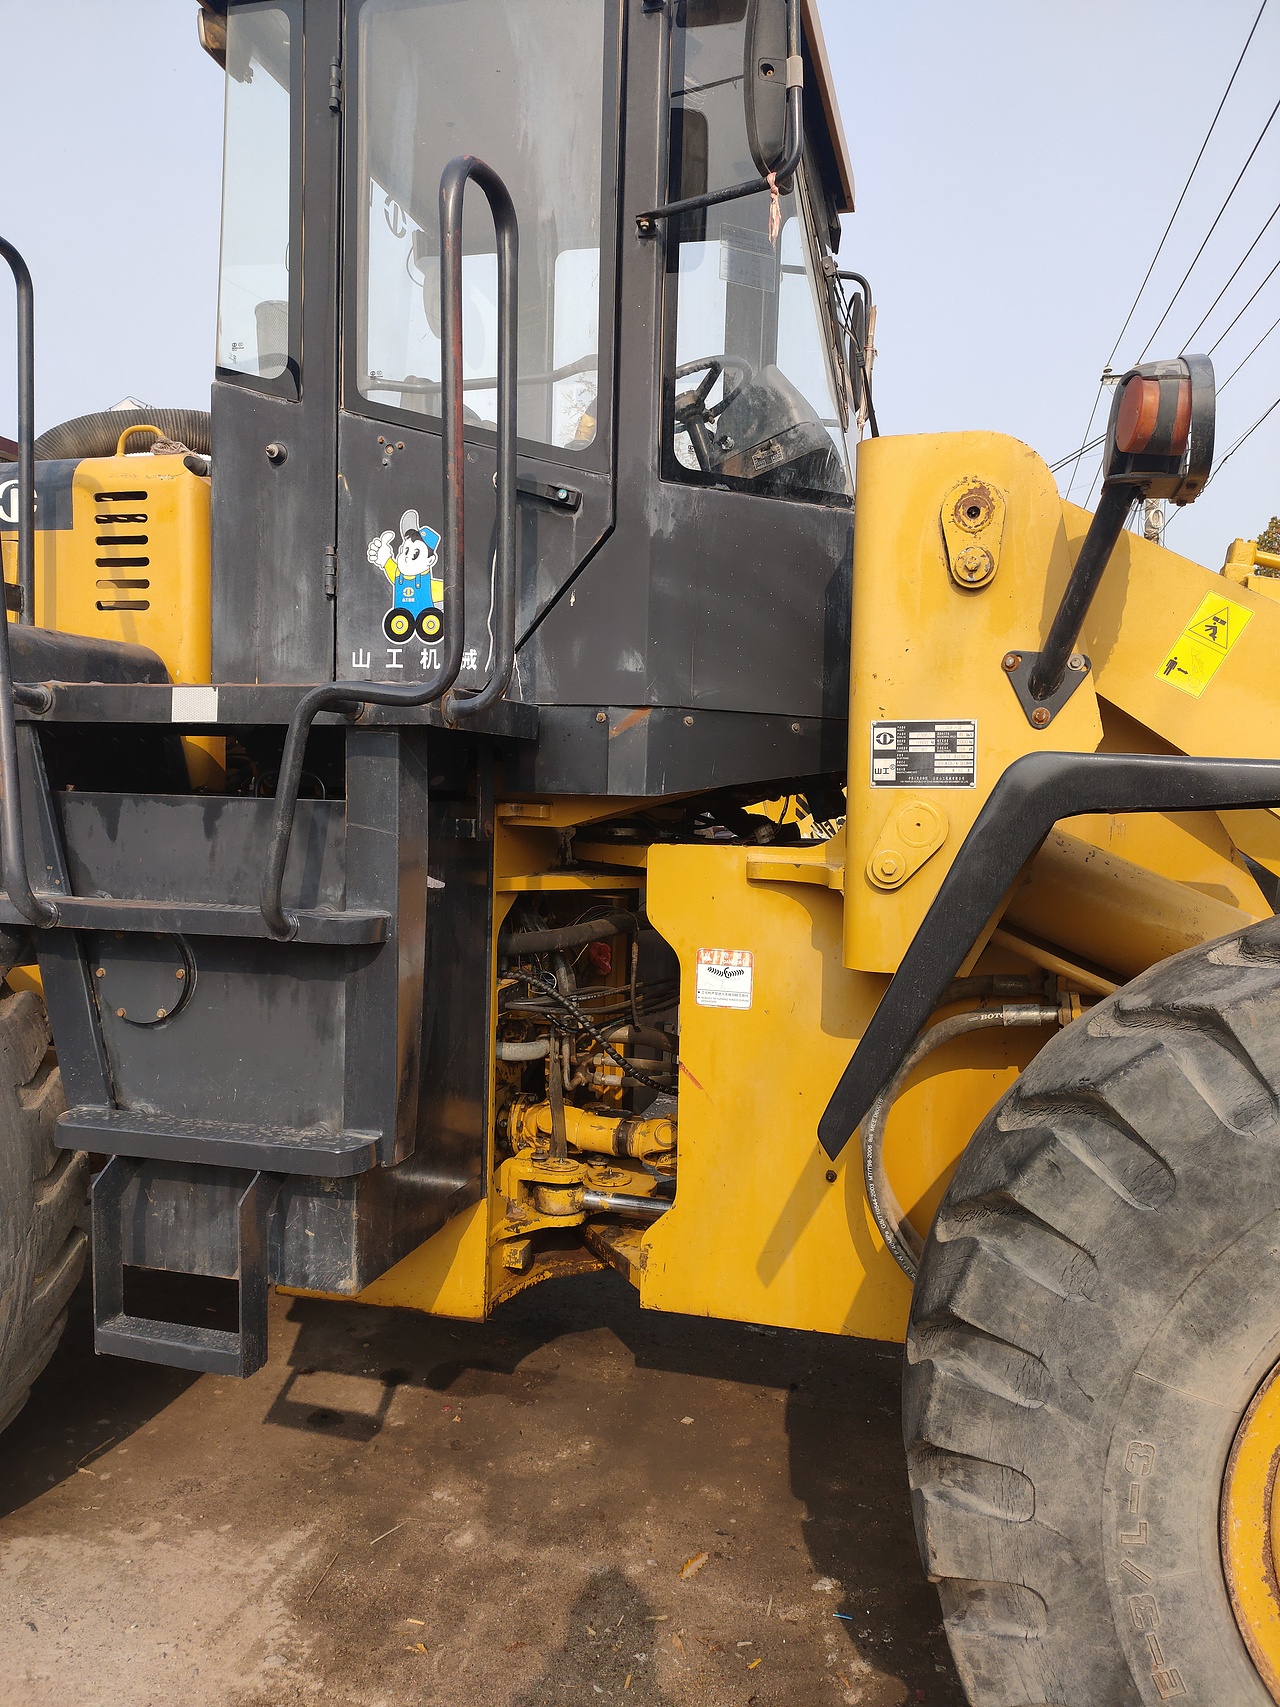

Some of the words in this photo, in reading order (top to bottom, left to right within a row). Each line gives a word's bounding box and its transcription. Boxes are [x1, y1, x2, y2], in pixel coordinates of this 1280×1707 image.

[352, 648, 478, 670] 山工机械
[1120, 1440, 1187, 1700] E-3/L-3
